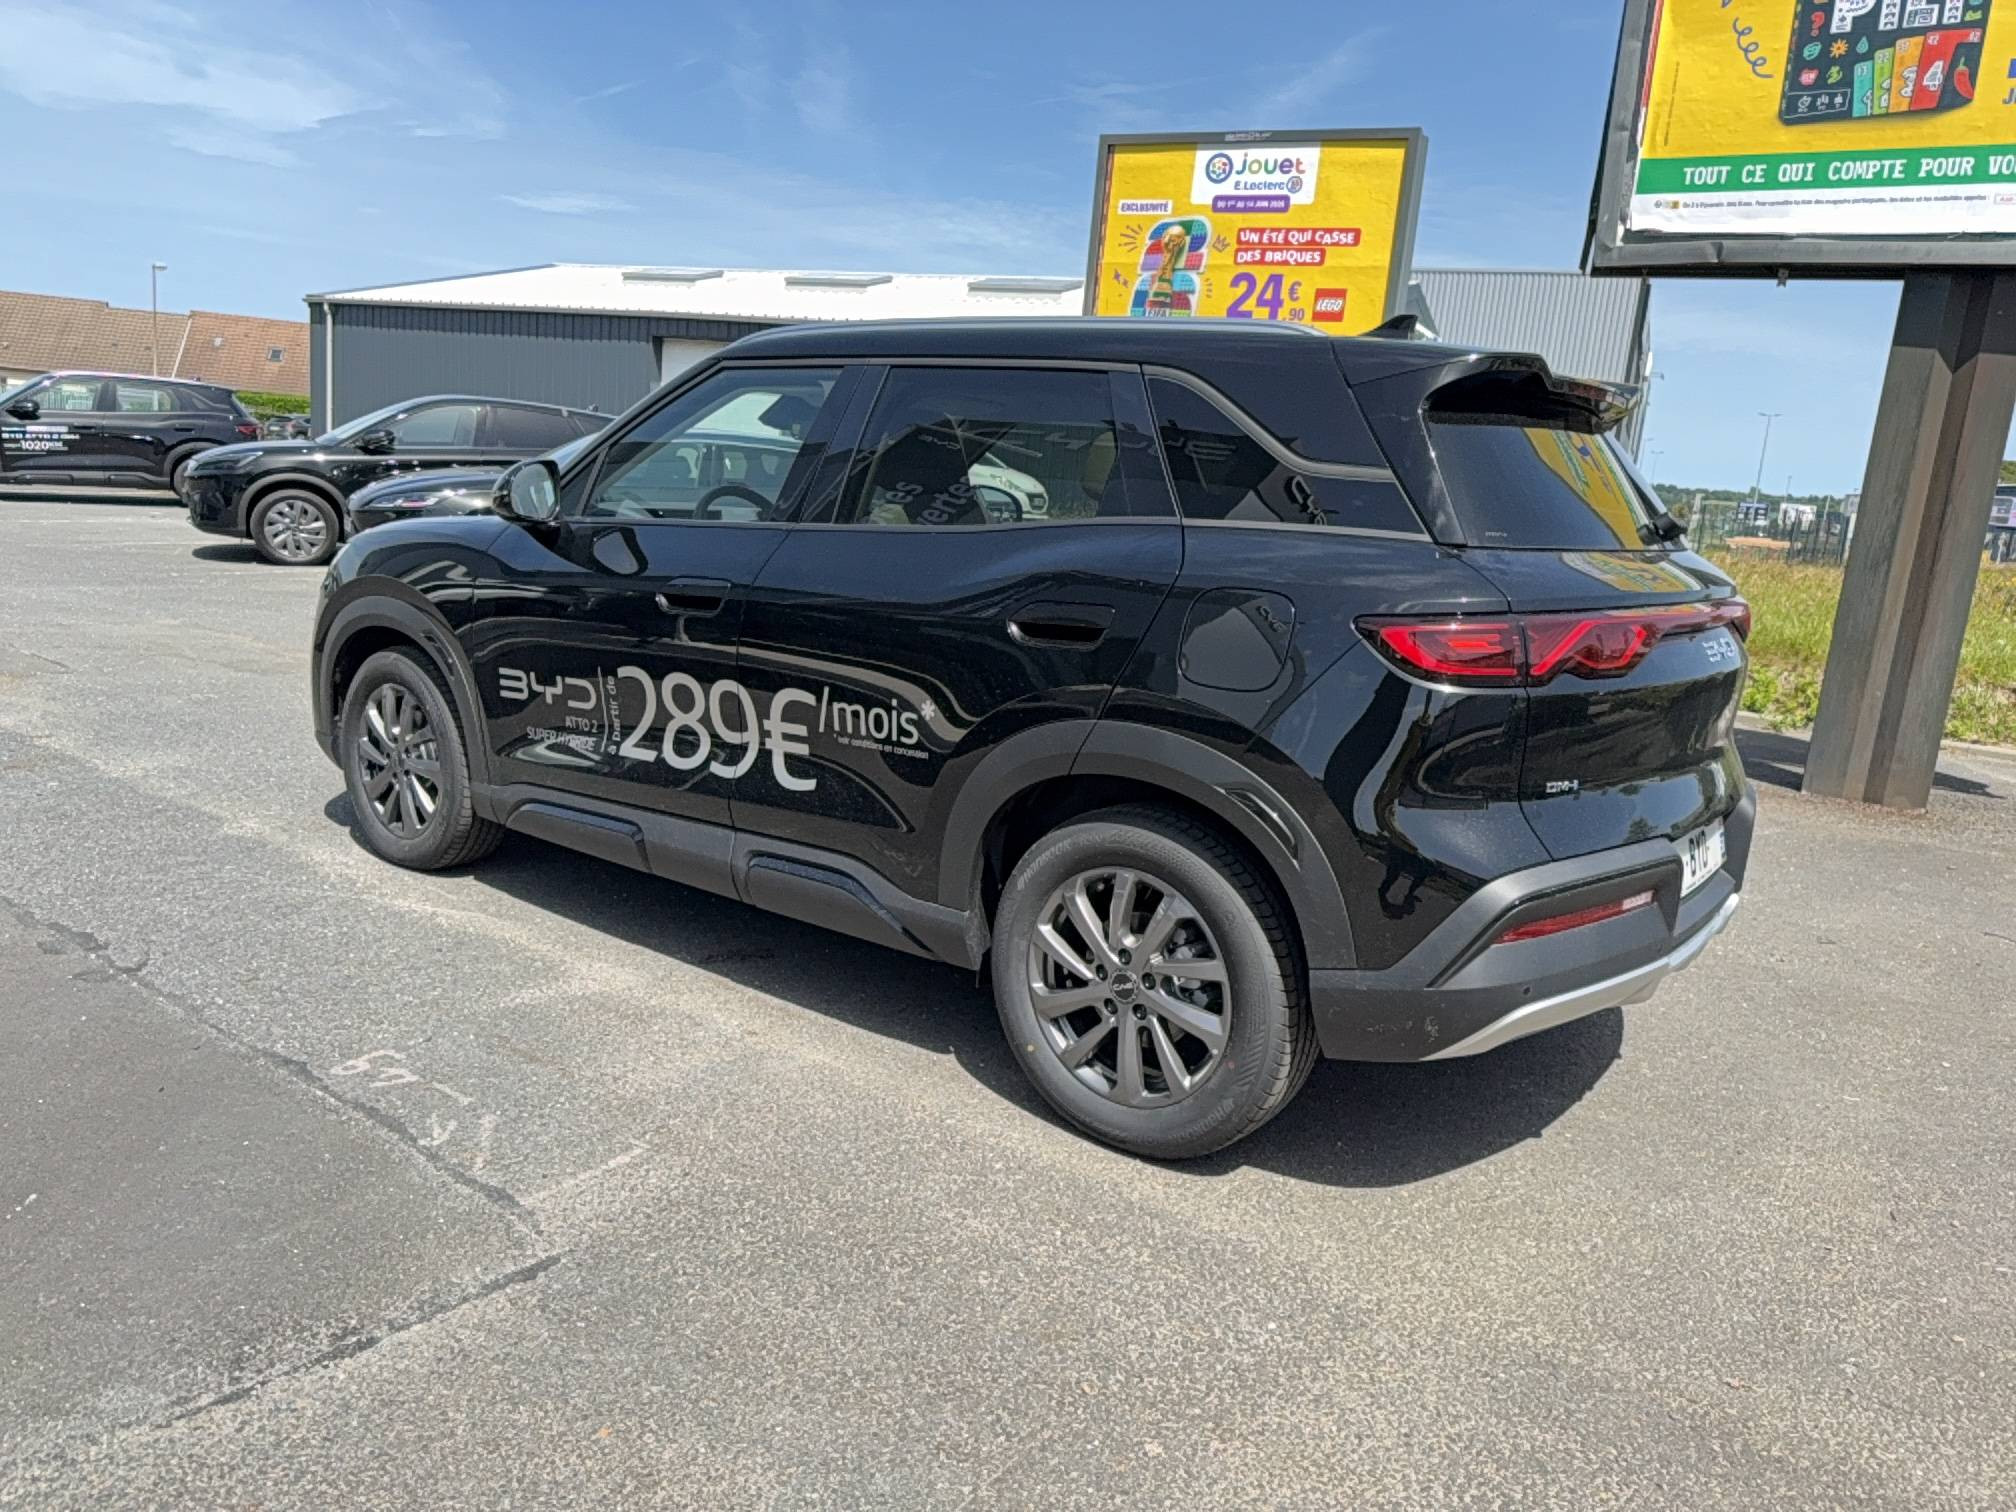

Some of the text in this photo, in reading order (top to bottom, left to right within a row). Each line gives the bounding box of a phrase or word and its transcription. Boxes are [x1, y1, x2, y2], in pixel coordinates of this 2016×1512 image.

[1235, 152, 1306, 175] jouet
[1683, 154, 2016, 185] TOUT CE QUI COMPTE POUR VO
[1240, 229, 1355, 245] UN ÉTÉ QUI CASSE
[1237, 249, 1321, 264] DES BRIQUES
[1226, 272, 1284, 320] 24
[499, 667, 597, 710] BYD
[565, 715, 598, 733] ATTO 2
[526, 726, 557, 743] SUPER
